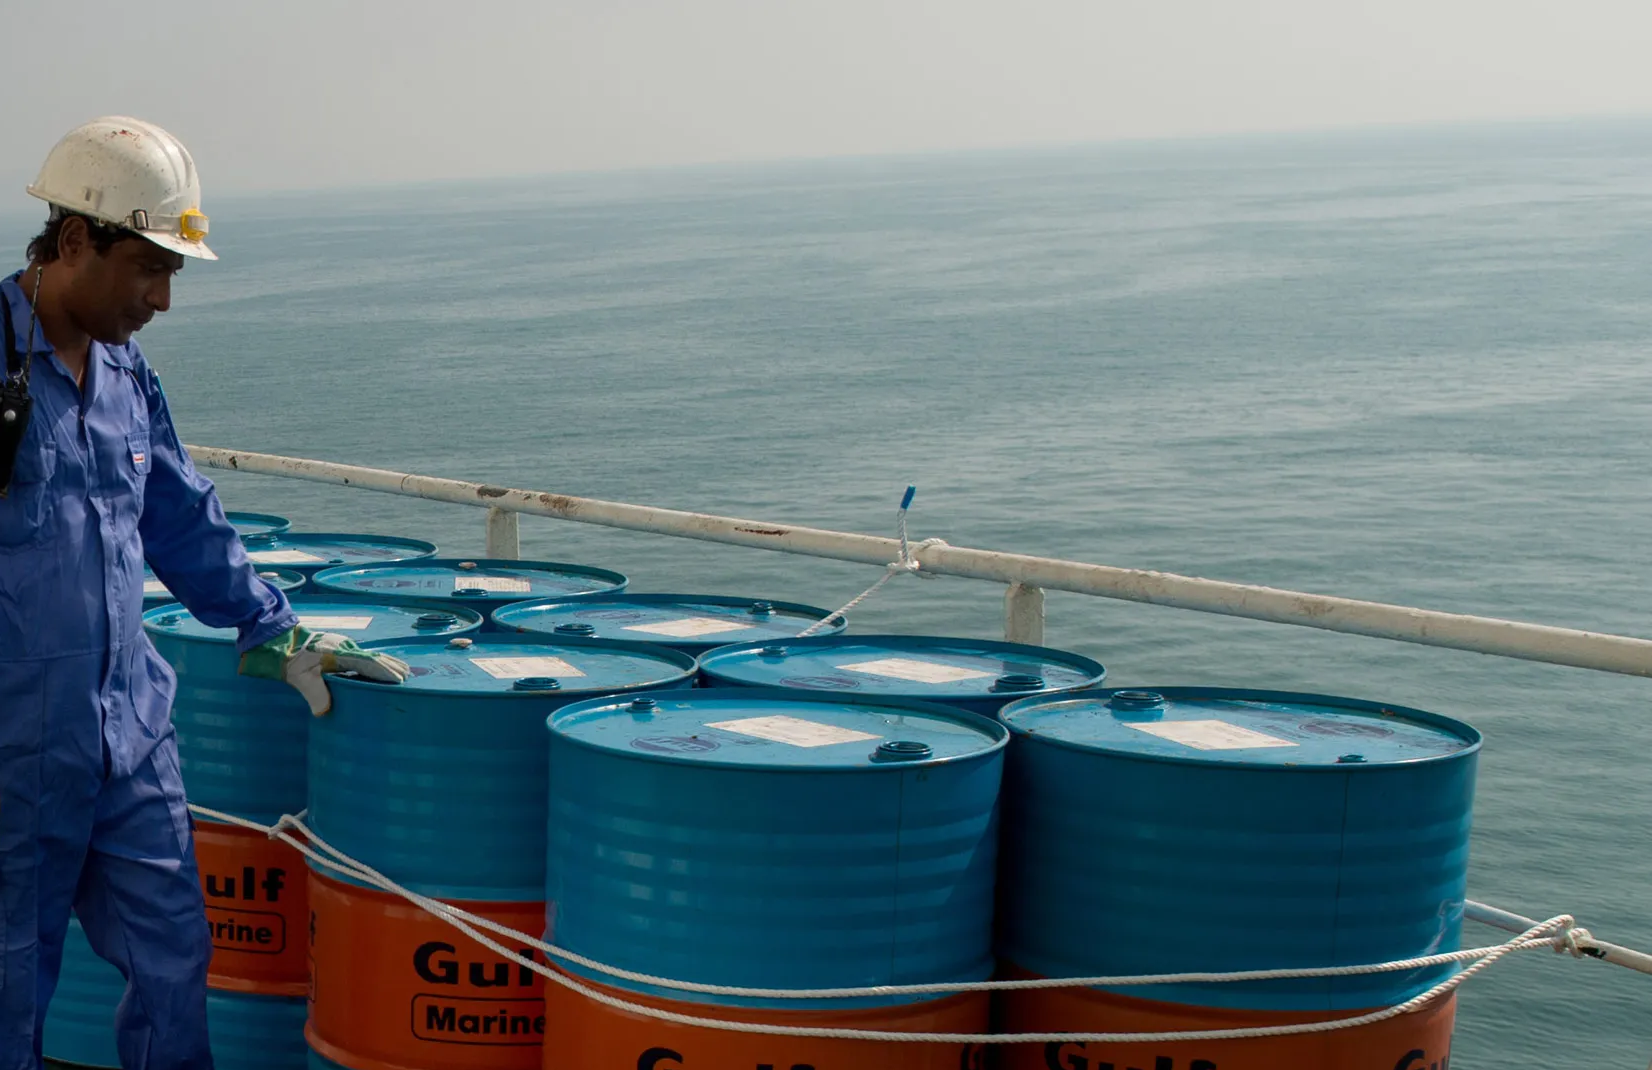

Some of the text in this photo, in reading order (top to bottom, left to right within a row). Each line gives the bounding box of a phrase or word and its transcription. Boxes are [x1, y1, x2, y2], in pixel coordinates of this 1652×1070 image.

[206, 867, 286, 901] ulf
[208, 918, 273, 944] rine
[413, 941, 535, 987] Gul
